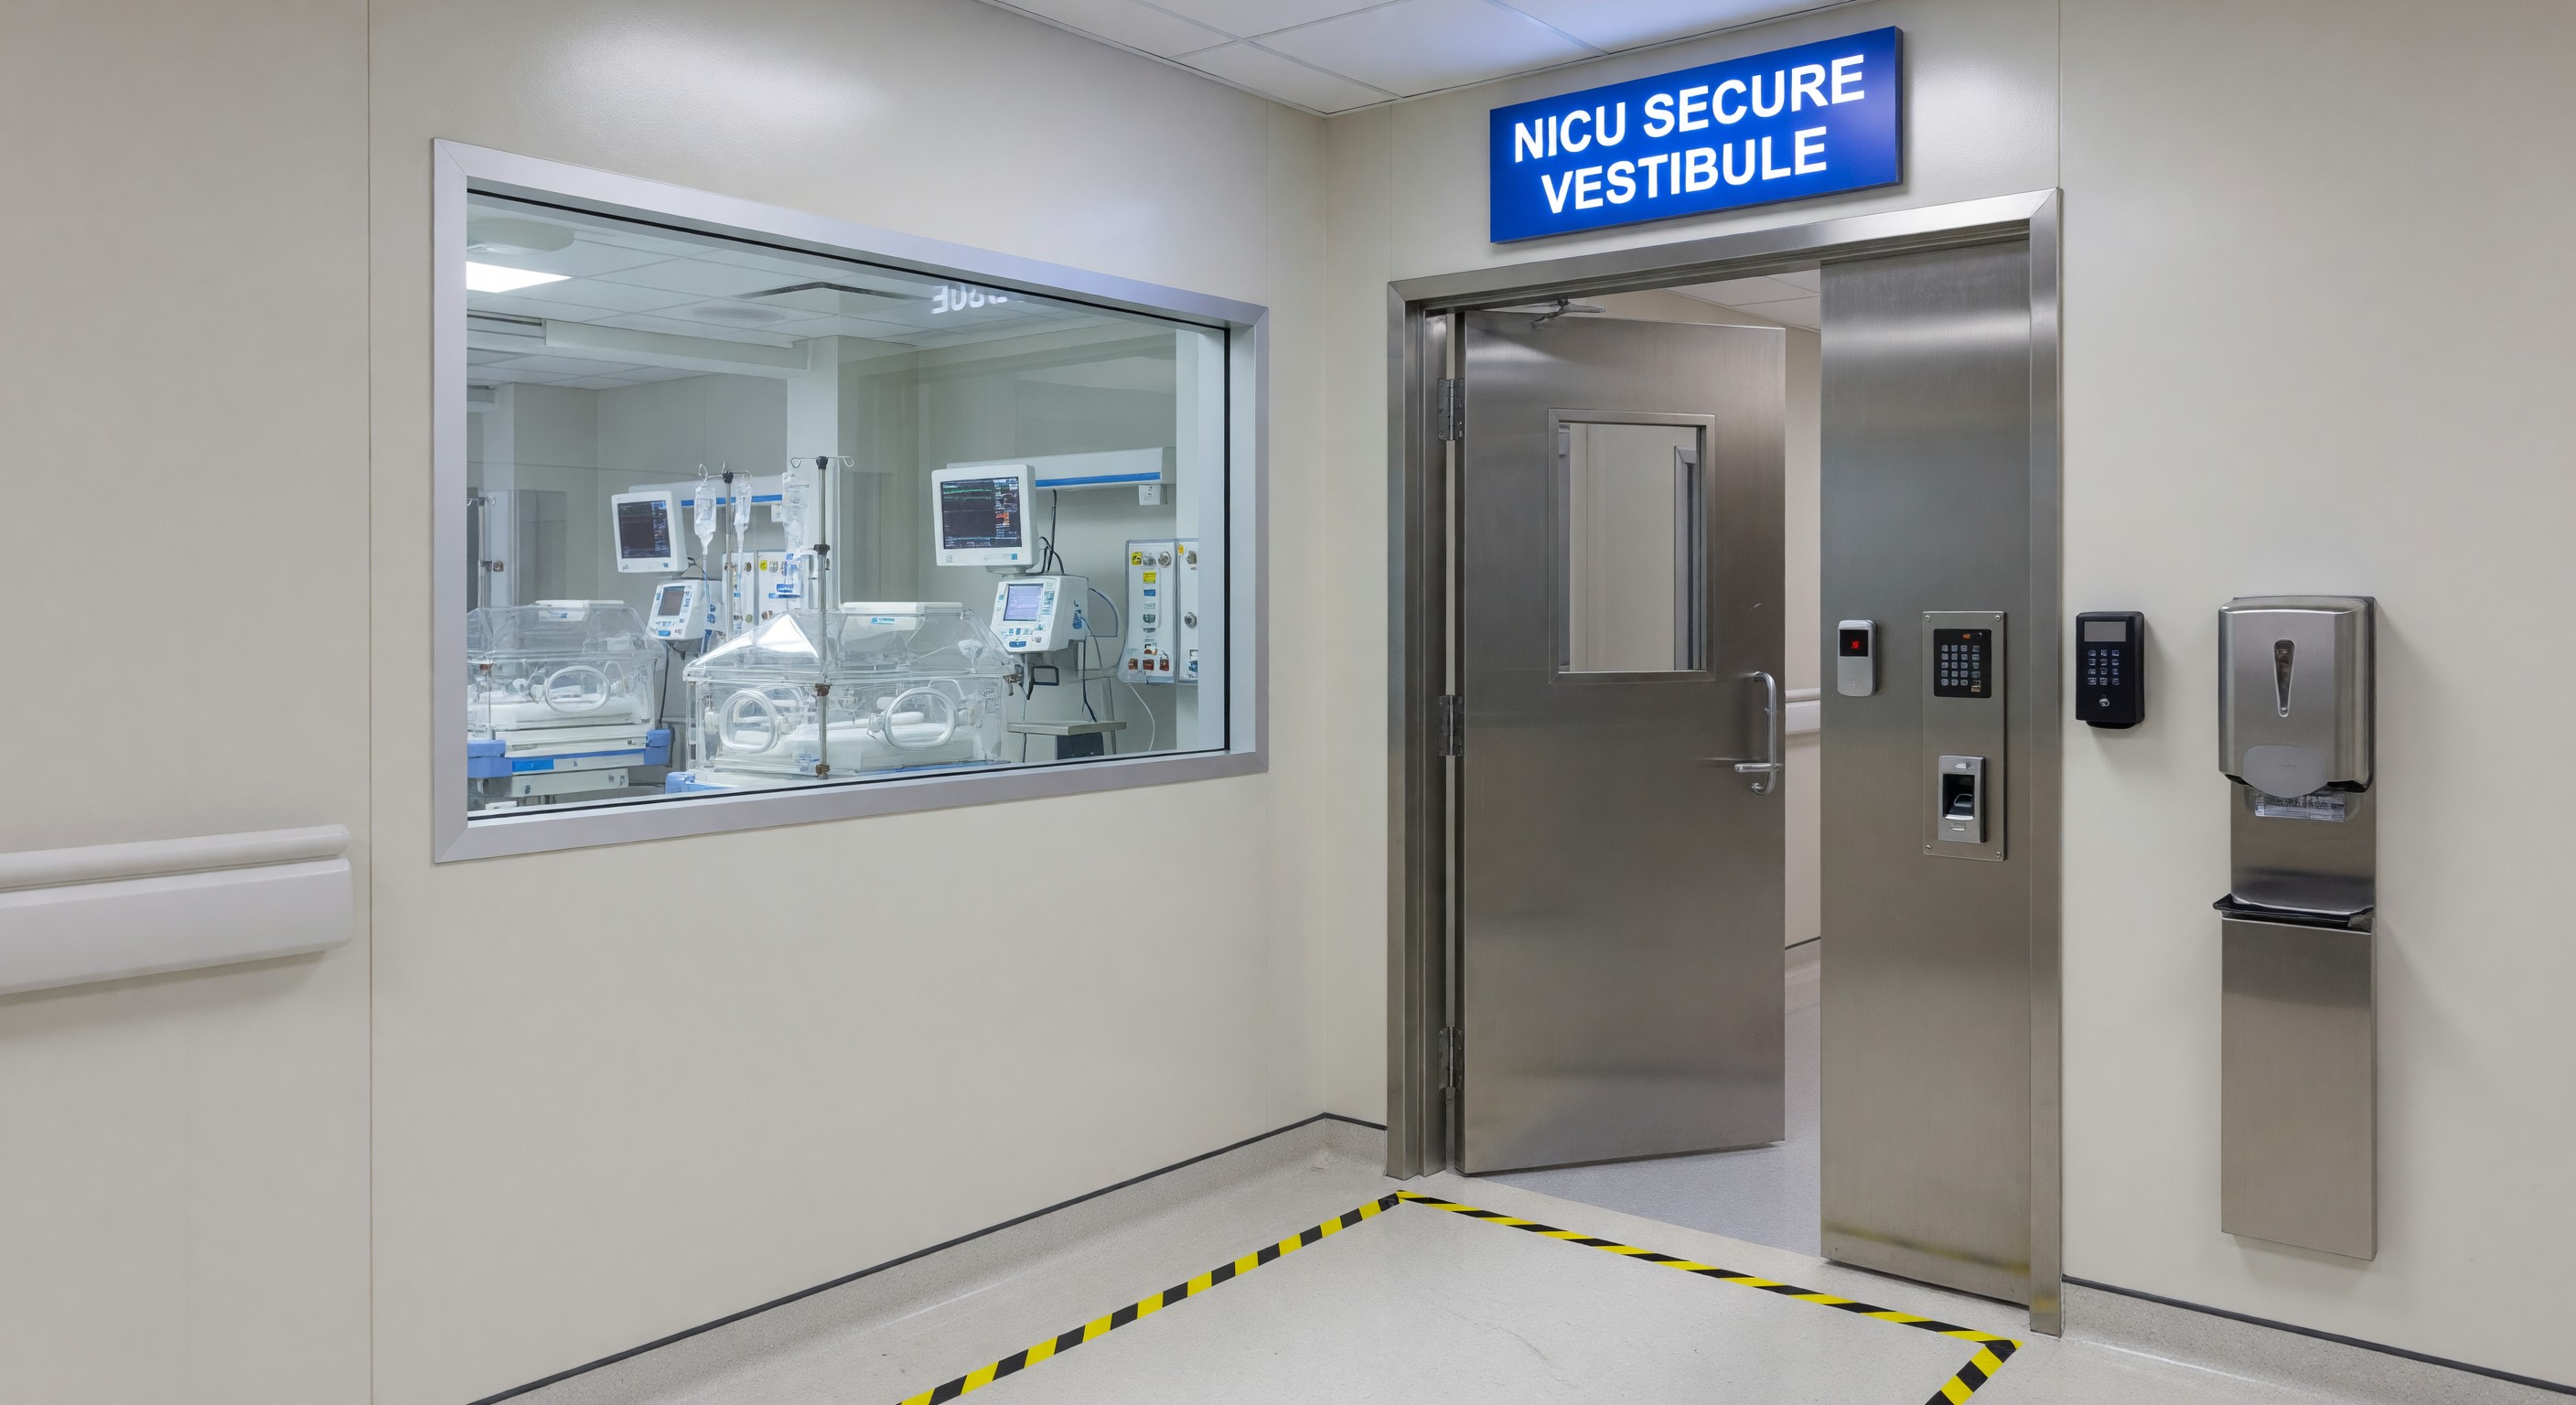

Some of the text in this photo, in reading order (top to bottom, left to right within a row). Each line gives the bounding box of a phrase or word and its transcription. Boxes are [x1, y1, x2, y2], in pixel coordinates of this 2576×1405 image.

[1514, 54, 1865, 163] NICU SECURE
[1540, 125, 1827, 214] VESTIBULE
